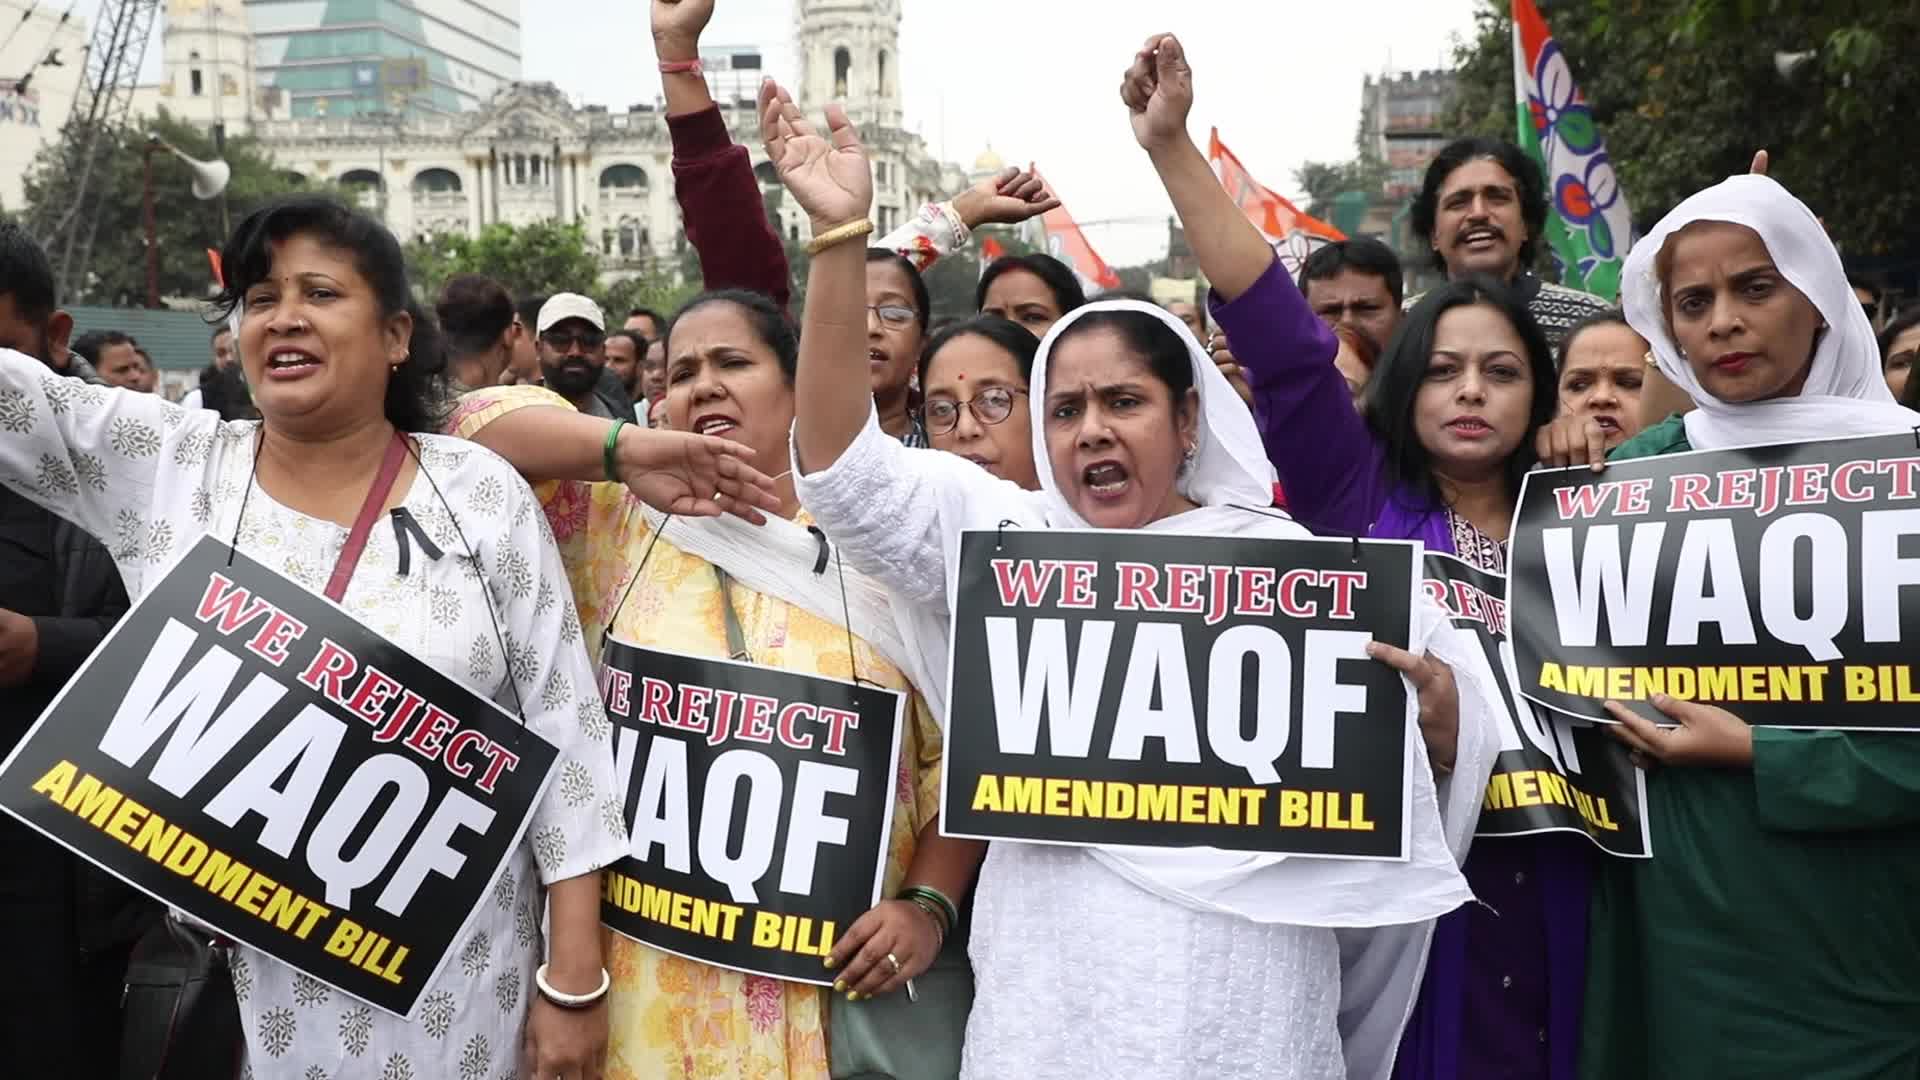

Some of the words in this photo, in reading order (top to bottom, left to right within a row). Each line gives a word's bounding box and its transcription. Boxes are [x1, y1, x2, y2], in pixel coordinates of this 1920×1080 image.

[1553, 479, 1651, 519] WE
[1667, 459, 1920, 517] REJECT
[991, 559, 1098, 609] WE
[1114, 562, 1368, 625] REJECT
[1542, 509, 1920, 662] WAQF
[194, 571, 308, 667] WE
[298, 637, 519, 794] REJECT
[640, 676, 859, 756] REJECT
[984, 616, 1373, 785] WAQF
[1539, 662, 1828, 702] AMENDMENT
[1844, 666, 1920, 702] BIL
[98, 617, 497, 917] WAQF
[972, 774, 1267, 826] AMENDMENT
[1280, 789, 1375, 831] BILL
[32, 759, 333, 940] AMENDMENT
[324, 918, 417, 986] BILL
[605, 868, 744, 941] NDMENT
